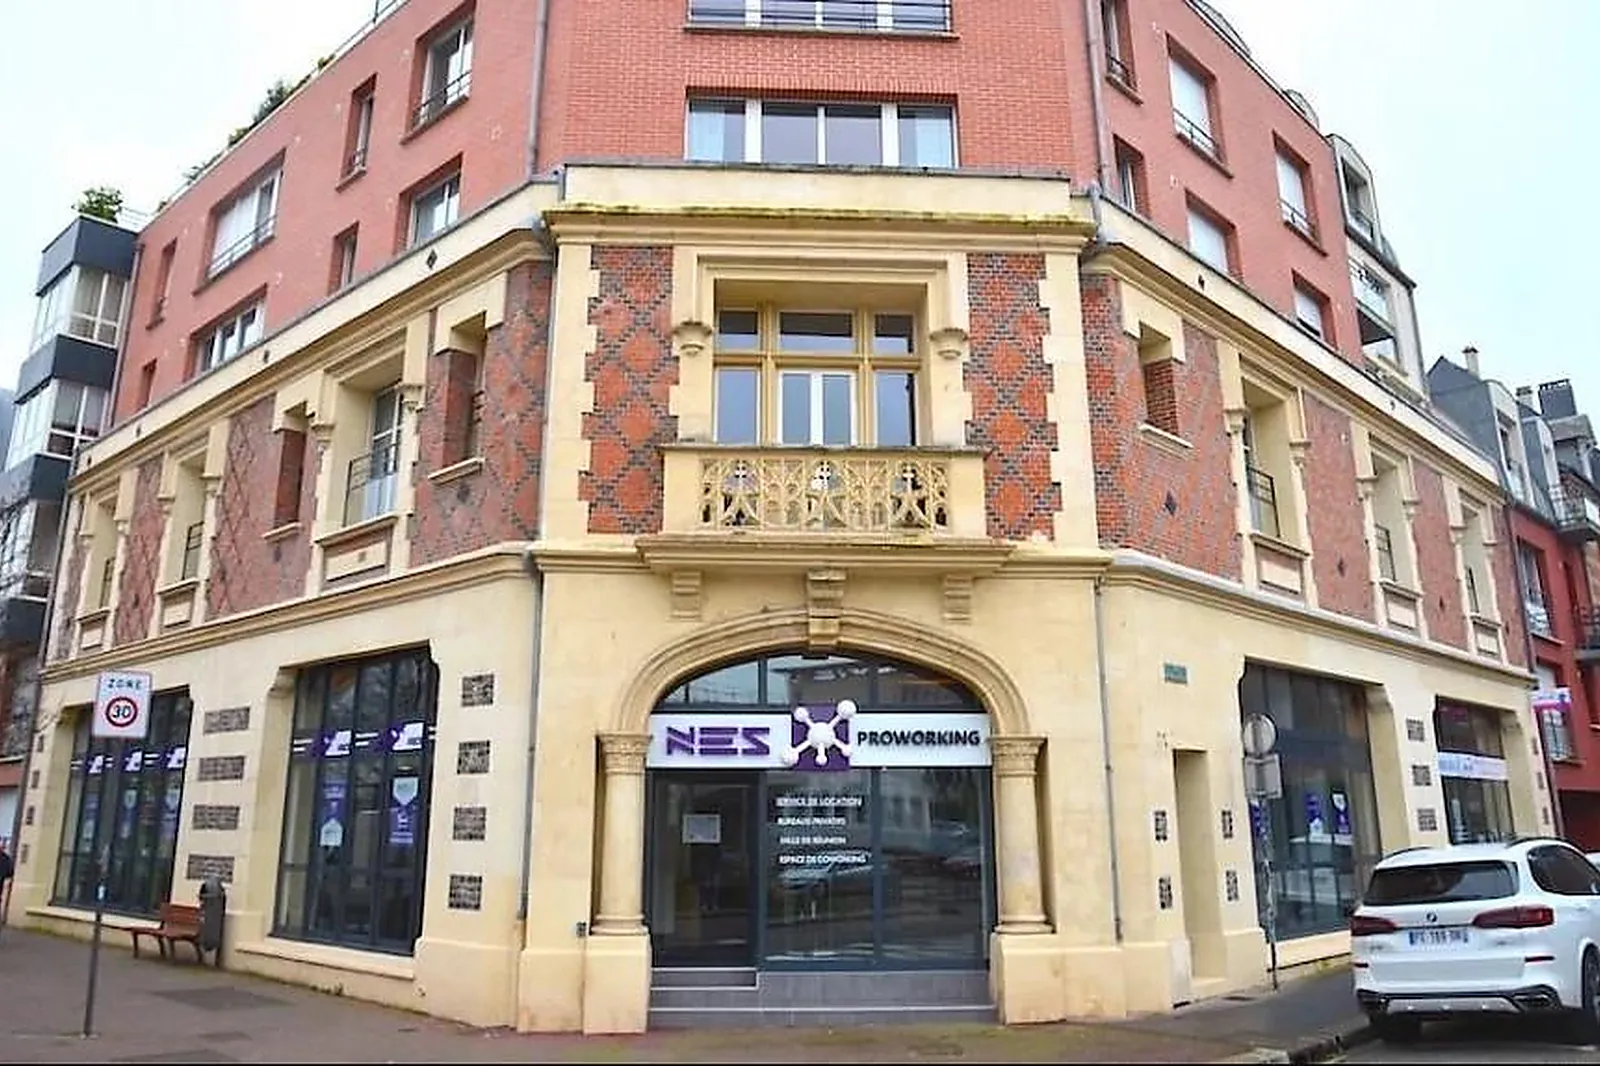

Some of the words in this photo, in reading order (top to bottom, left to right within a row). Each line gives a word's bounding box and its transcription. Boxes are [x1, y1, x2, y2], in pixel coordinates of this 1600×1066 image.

[108, 678, 142, 690] ZONE
[111, 704, 132, 719] 30
[666, 727, 770, 755] NES
[857, 729, 981, 746] PROWORKING
[819, 797, 863, 807] LOCATION
[779, 855, 805, 864] ESPACE
[817, 855, 867, 864] COWORKING
